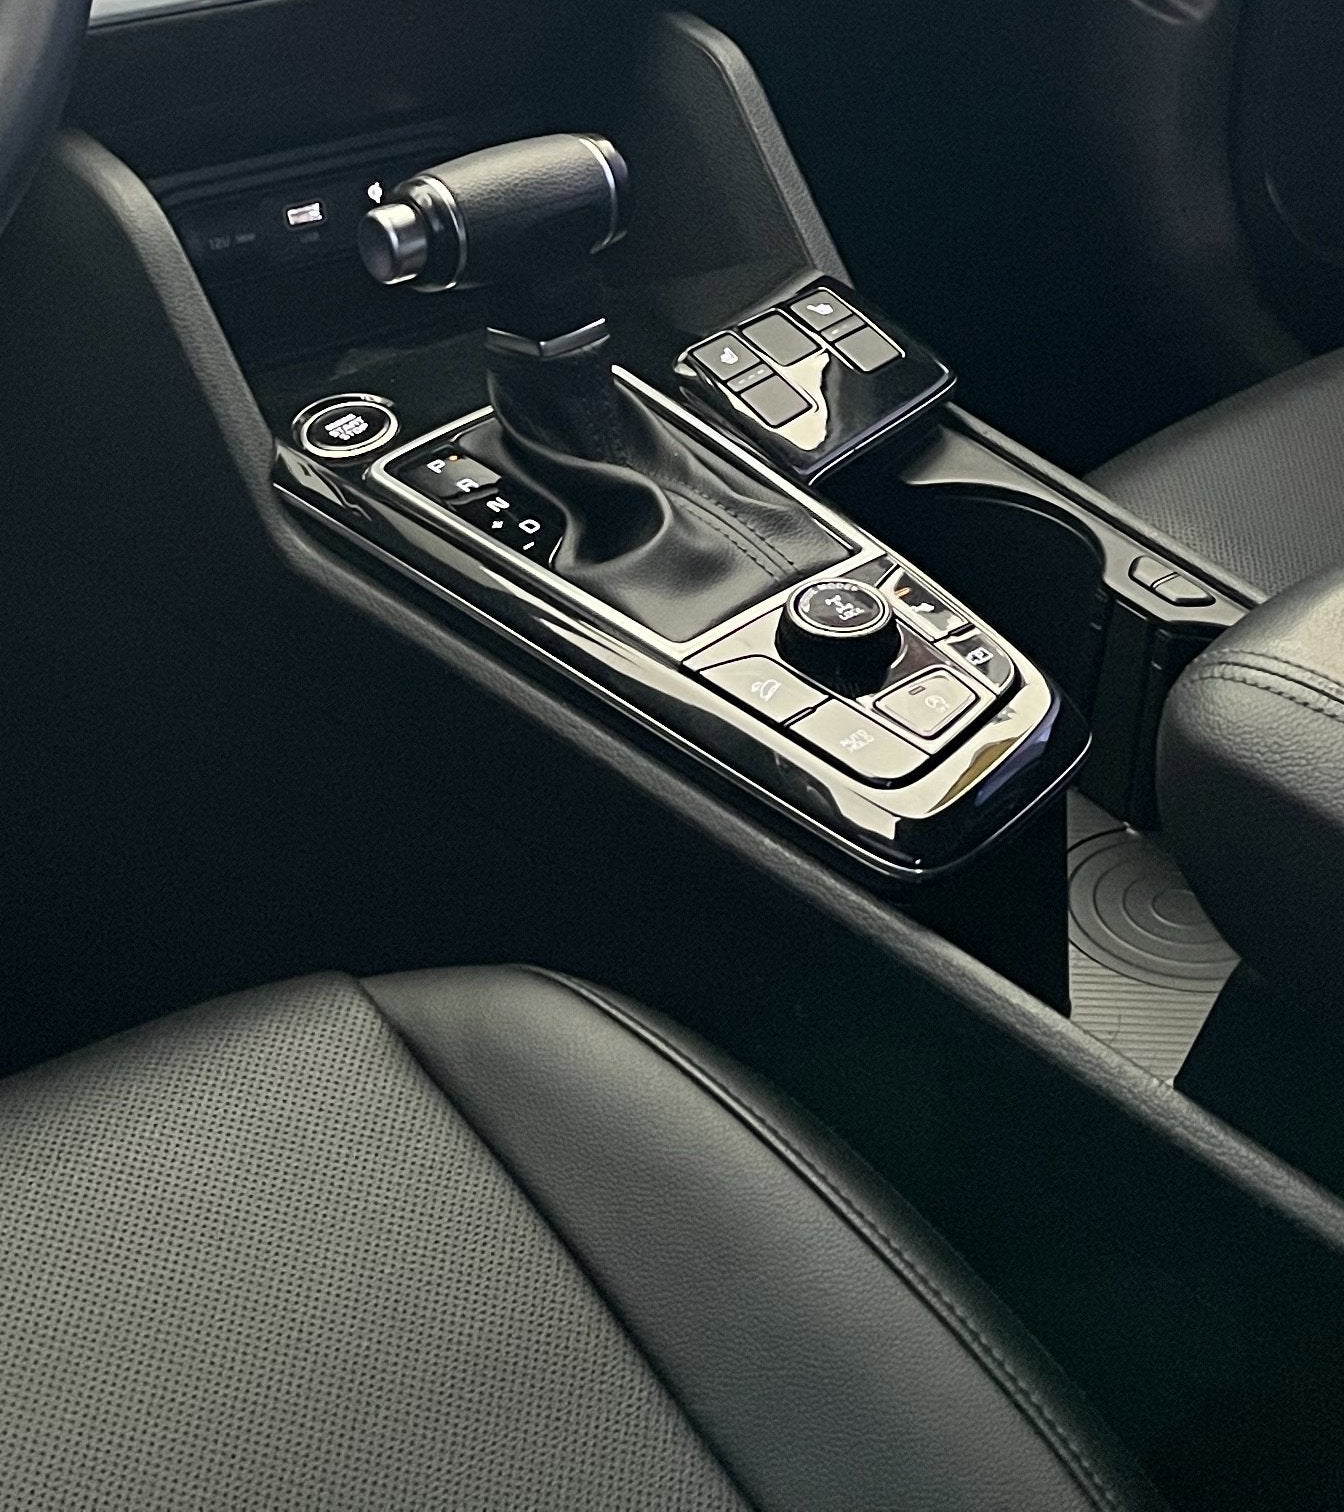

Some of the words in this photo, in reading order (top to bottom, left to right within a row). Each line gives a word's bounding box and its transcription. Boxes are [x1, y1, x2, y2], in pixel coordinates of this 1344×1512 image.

[427, 459, 447, 474] P
[456, 478, 480, 493] R
[486, 496, 510, 513] N
[518, 518, 541, 534] D
